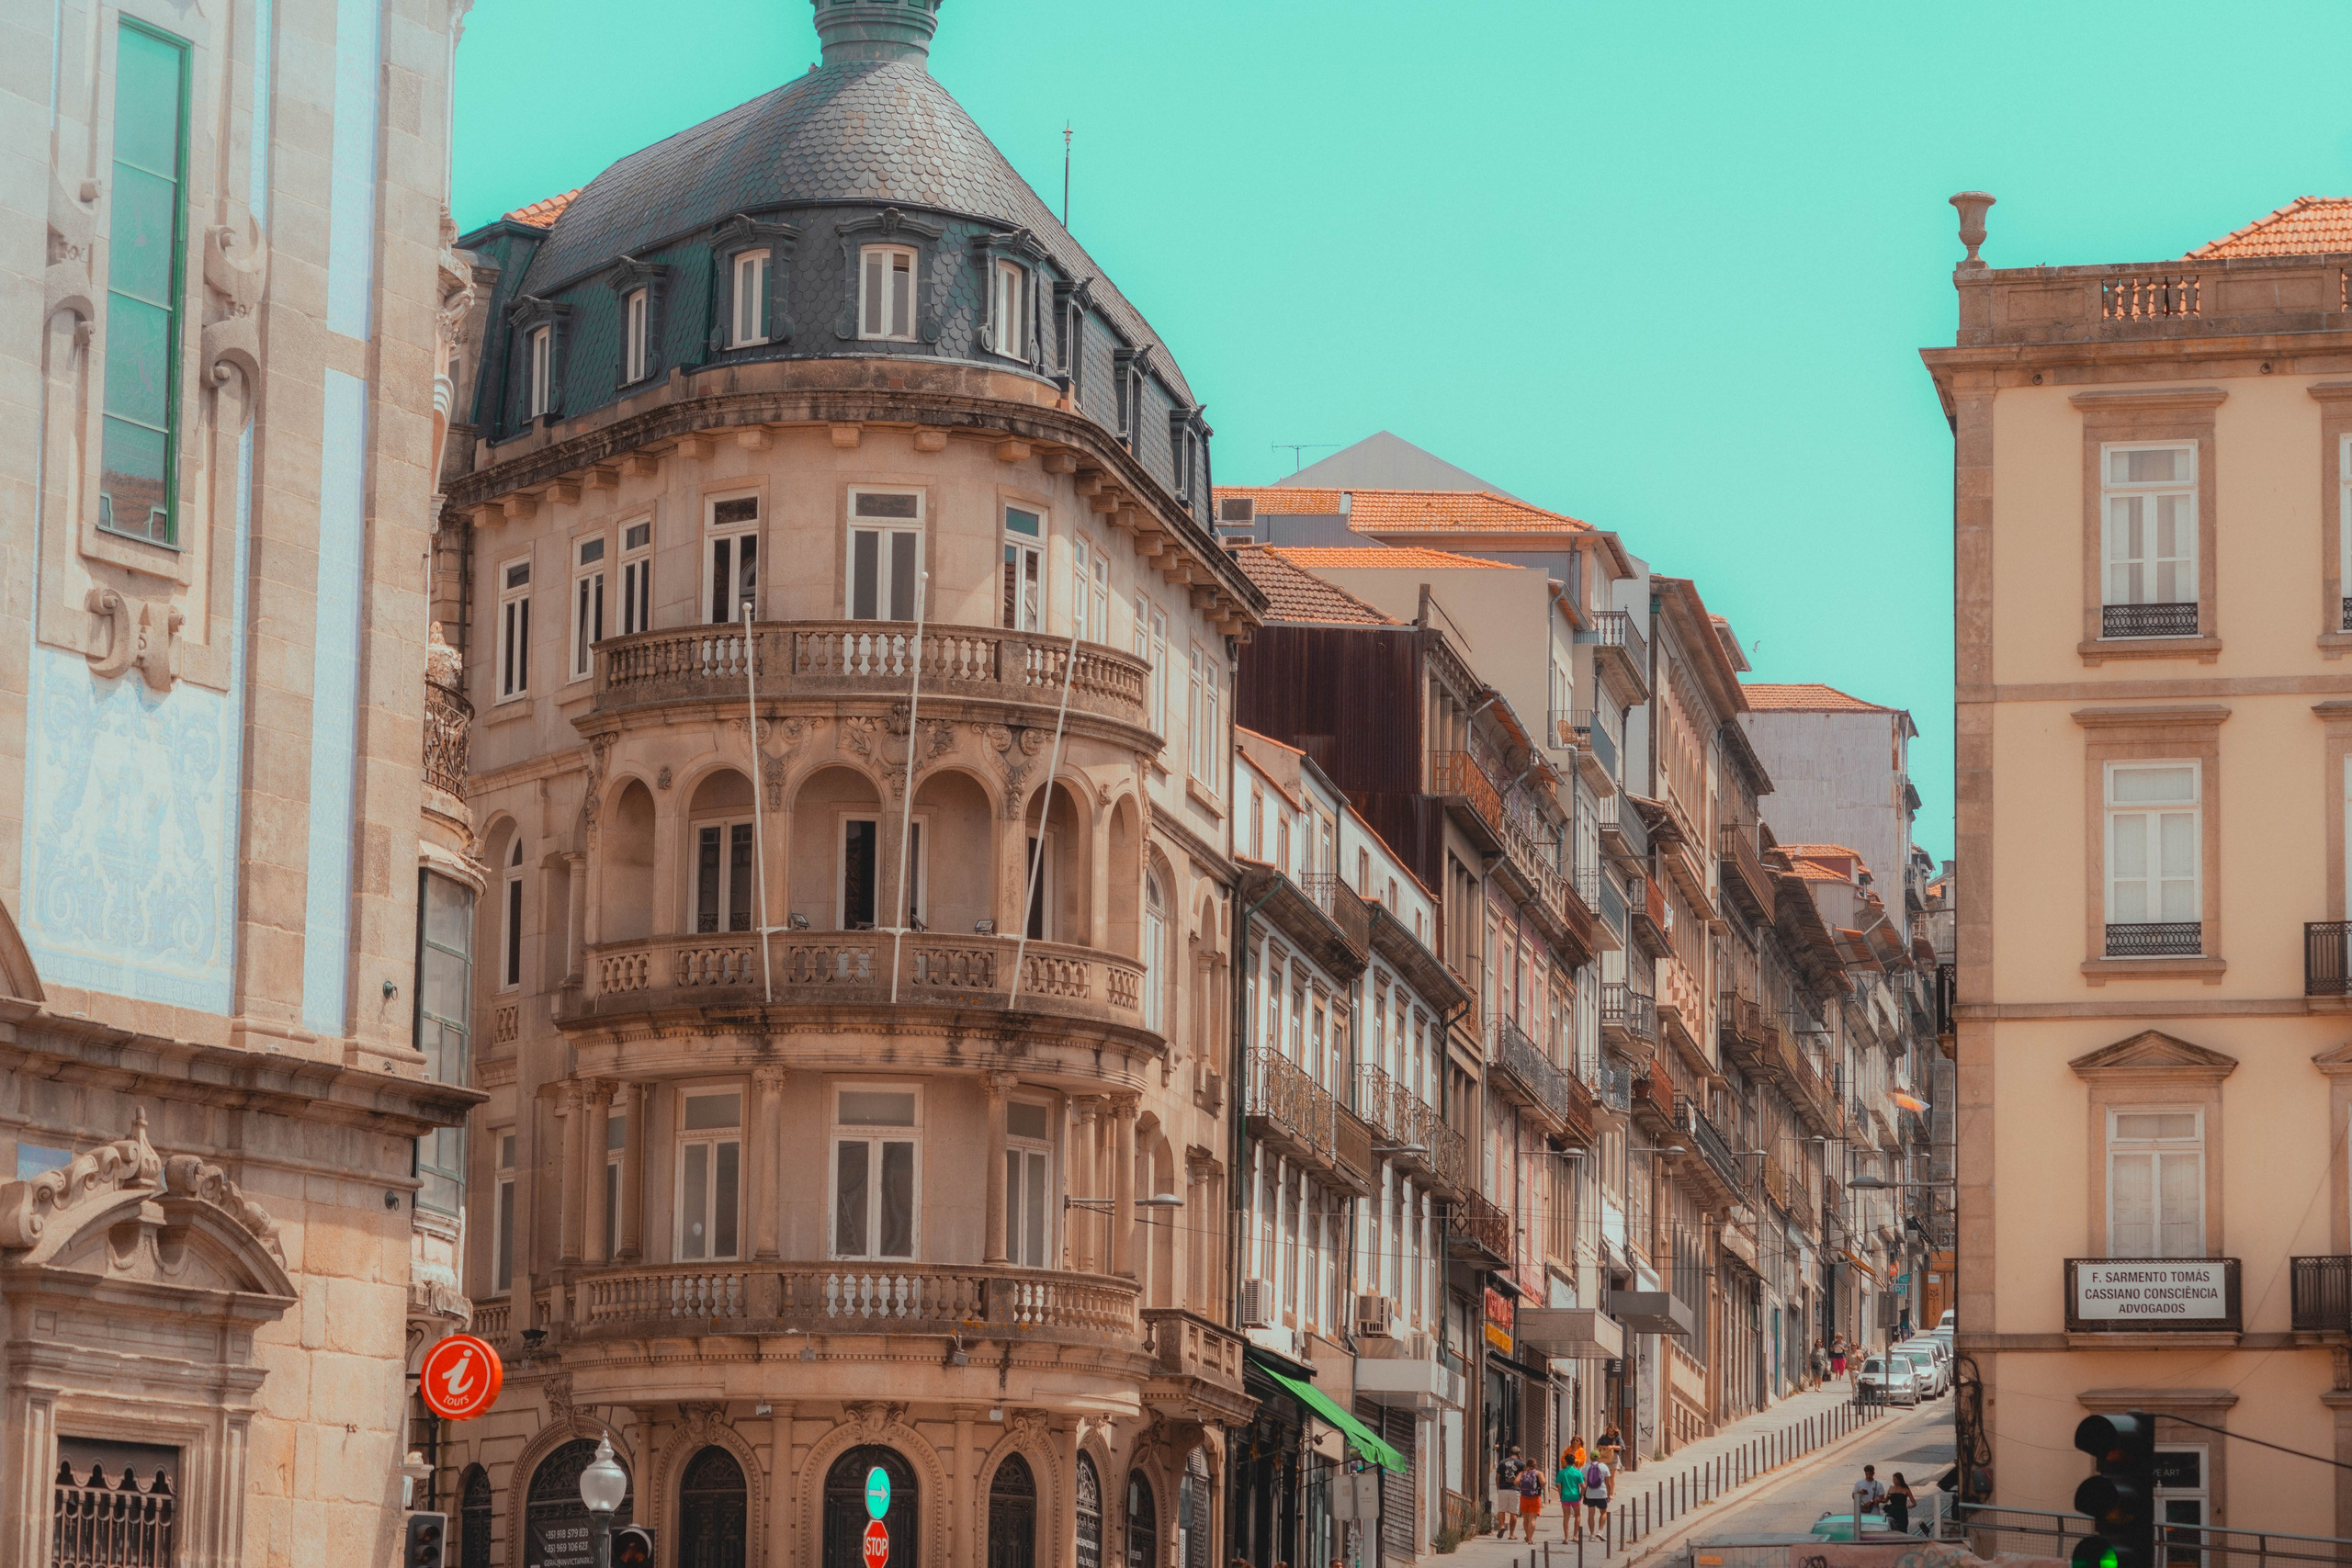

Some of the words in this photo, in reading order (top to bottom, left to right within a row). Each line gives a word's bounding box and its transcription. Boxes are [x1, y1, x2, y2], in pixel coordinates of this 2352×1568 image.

[2092, 1272, 2102, 1283] F.
[2105, 1271, 2167, 1283] SARMENTO
[2170, 1269, 2211, 1282] TOMÁS
[2085, 1288, 2141, 1300] CASSIANO
[2143, 1286, 2218, 1299] CONSCIÊNCIA
[2119, 1303, 2186, 1314] ADVOGADOS
[443, 1394, 469, 1406] tours
[2164, 1468, 2180, 1477] ART
[557, 1529, 566, 1539] 918
[567, 1529, 579, 1539] 579
[579, 1528, 589, 1537] 839
[568, 1541, 578, 1551] 106
[578, 1541, 588, 1551] 623
[865, 1537, 888, 1557] STOP
